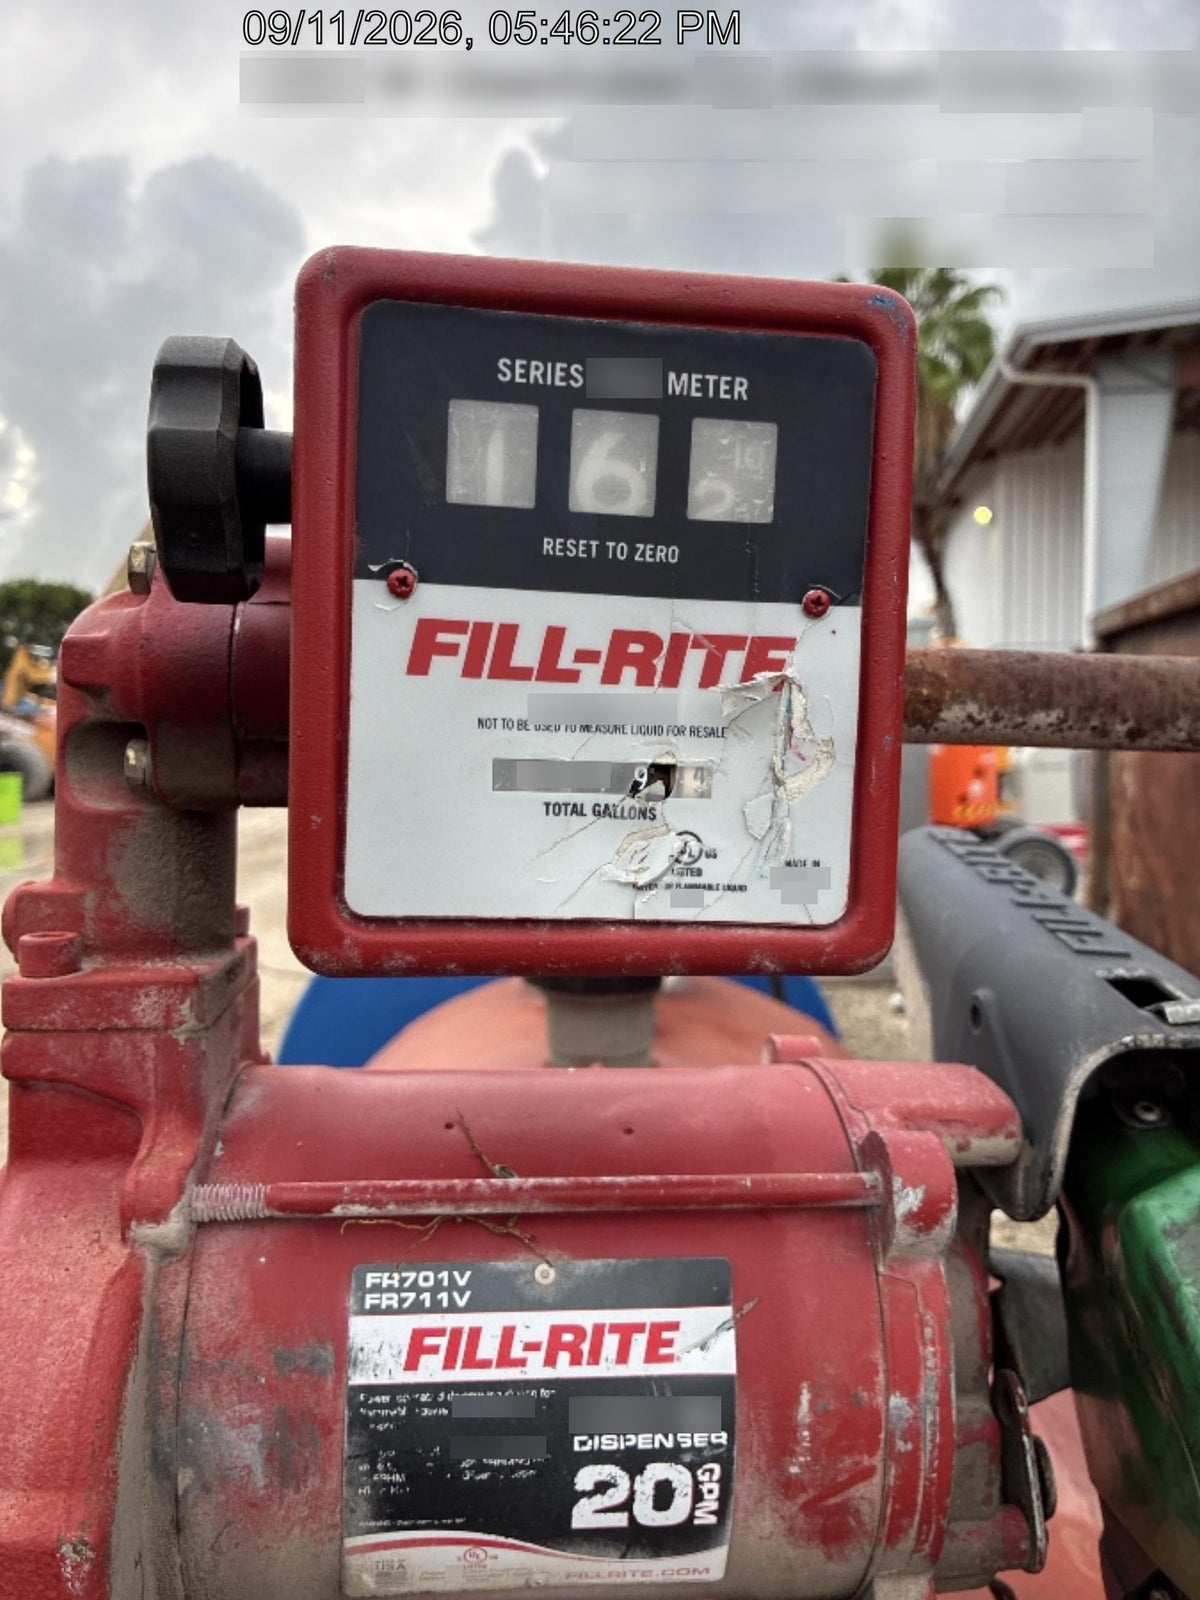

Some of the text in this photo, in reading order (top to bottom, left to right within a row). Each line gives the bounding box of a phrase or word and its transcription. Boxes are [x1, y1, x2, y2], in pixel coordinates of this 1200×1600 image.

[497, 358, 749, 400] SERIES METER
[576, 430, 647, 515] 6
[543, 537, 680, 564] RESET TO ZERO
[406, 618, 797, 692] FILL-RITE
[477, 717, 498, 730] NOT
[501, 718, 514, 731] TO
[516, 719, 531, 732] BE
[579, 724, 628, 735] MEASURE
[630, 724, 664, 737] LIQUID
[666, 724, 686, 737] FOR
[689, 725, 729, 739] RESALE
[544, 802, 657, 820] TOTAL GALLONS
[365, 1270, 472, 1289] FR701V
[364, 1290, 471, 1309] FR711V
[403, 1320, 681, 1372] FILL-RITE
[573, 1431, 728, 1451] DISPENSER
[571, 1462, 721, 1530] 20 GPM
